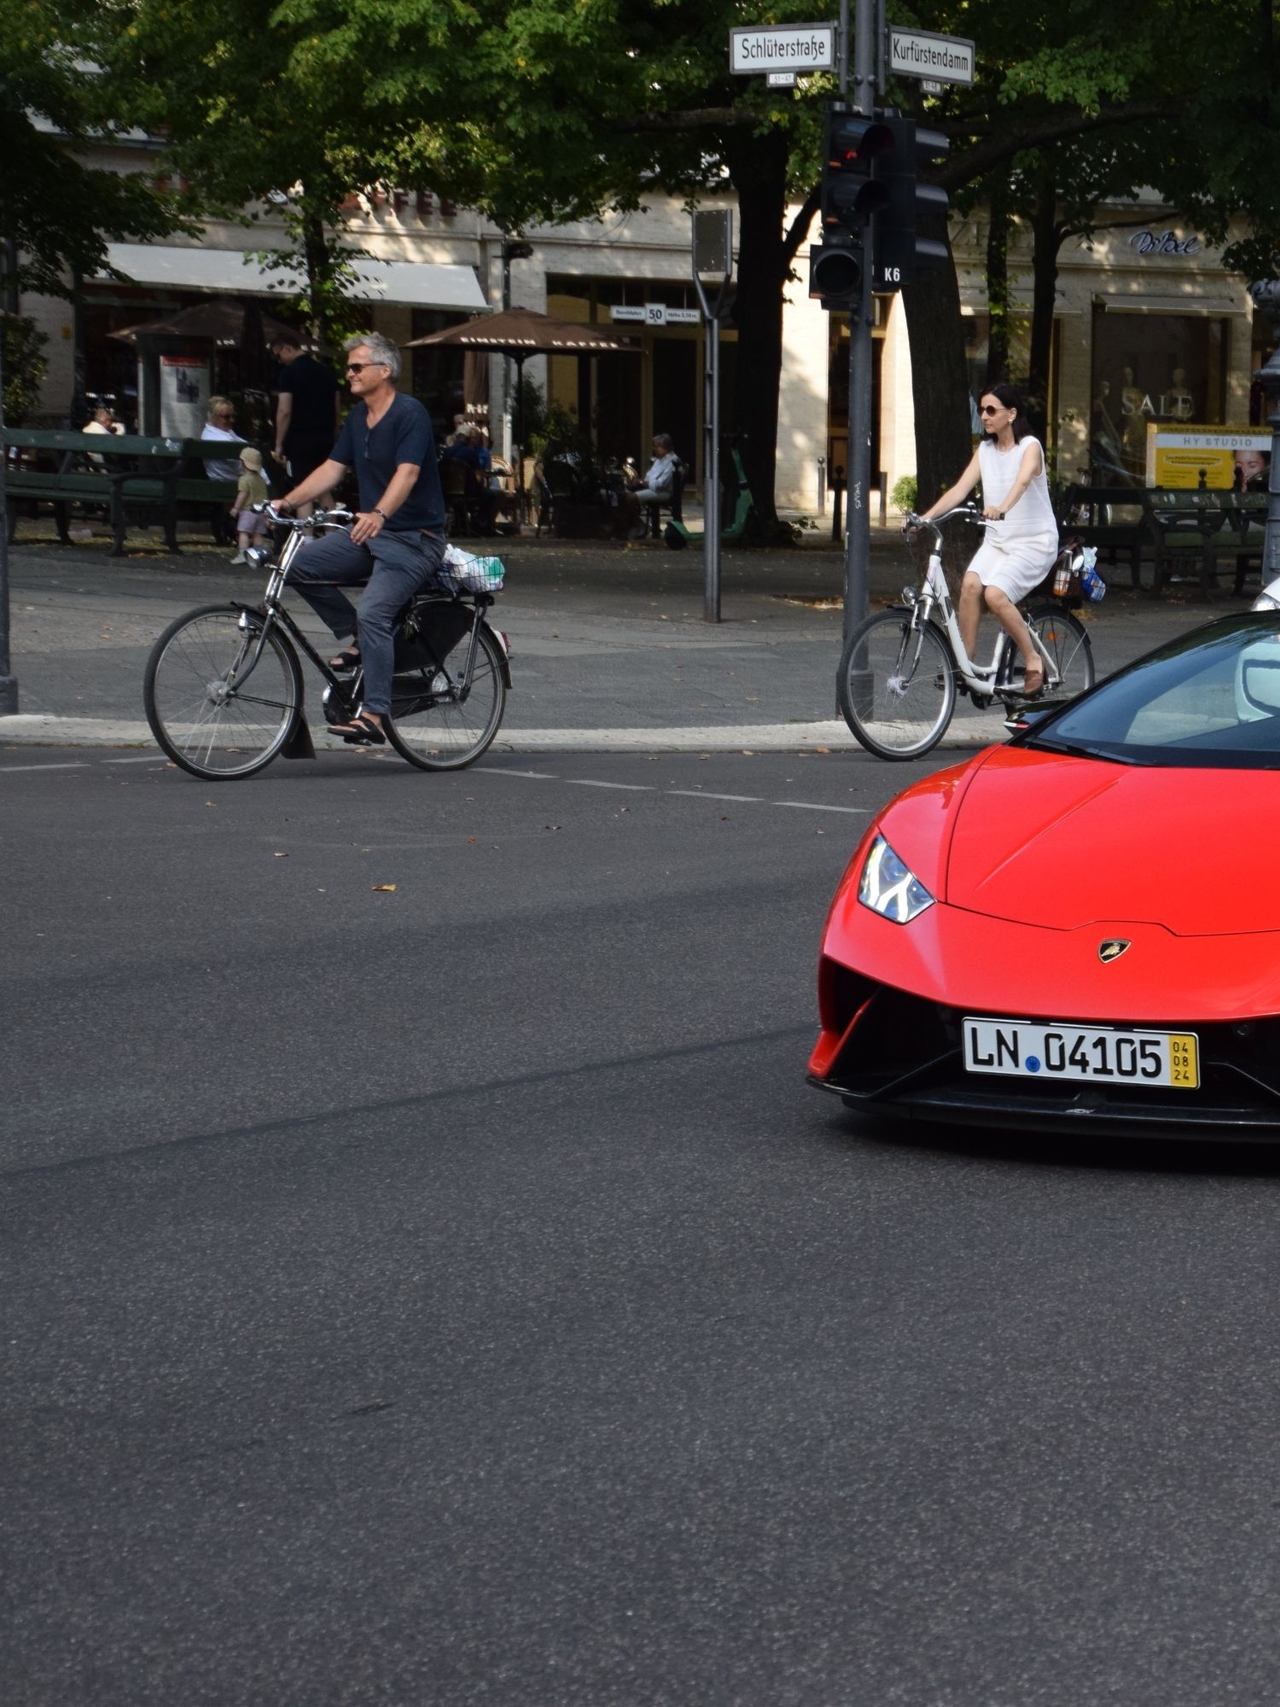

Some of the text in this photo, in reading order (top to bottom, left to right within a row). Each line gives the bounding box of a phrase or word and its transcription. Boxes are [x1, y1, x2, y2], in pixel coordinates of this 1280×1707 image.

[742, 35, 825, 60] Schlüterstraße
[893, 37, 969, 71] Kurfürstendamm
[884, 267, 901, 282] K6
[648, 309, 662, 320] 50
[460, 337, 536, 345] EINSTEIN
[552, 340, 619, 348] KAFFEE
[1121, 394, 1194, 417] SALE
[1183, 437, 1252, 447] HY STUDIO
[971, 1026, 1162, 1078] LN 04105
[1173, 1041, 1188, 1053] 04
[1173, 1055, 1189, 1067] 08
[1174, 1069, 1190, 1081] 24
